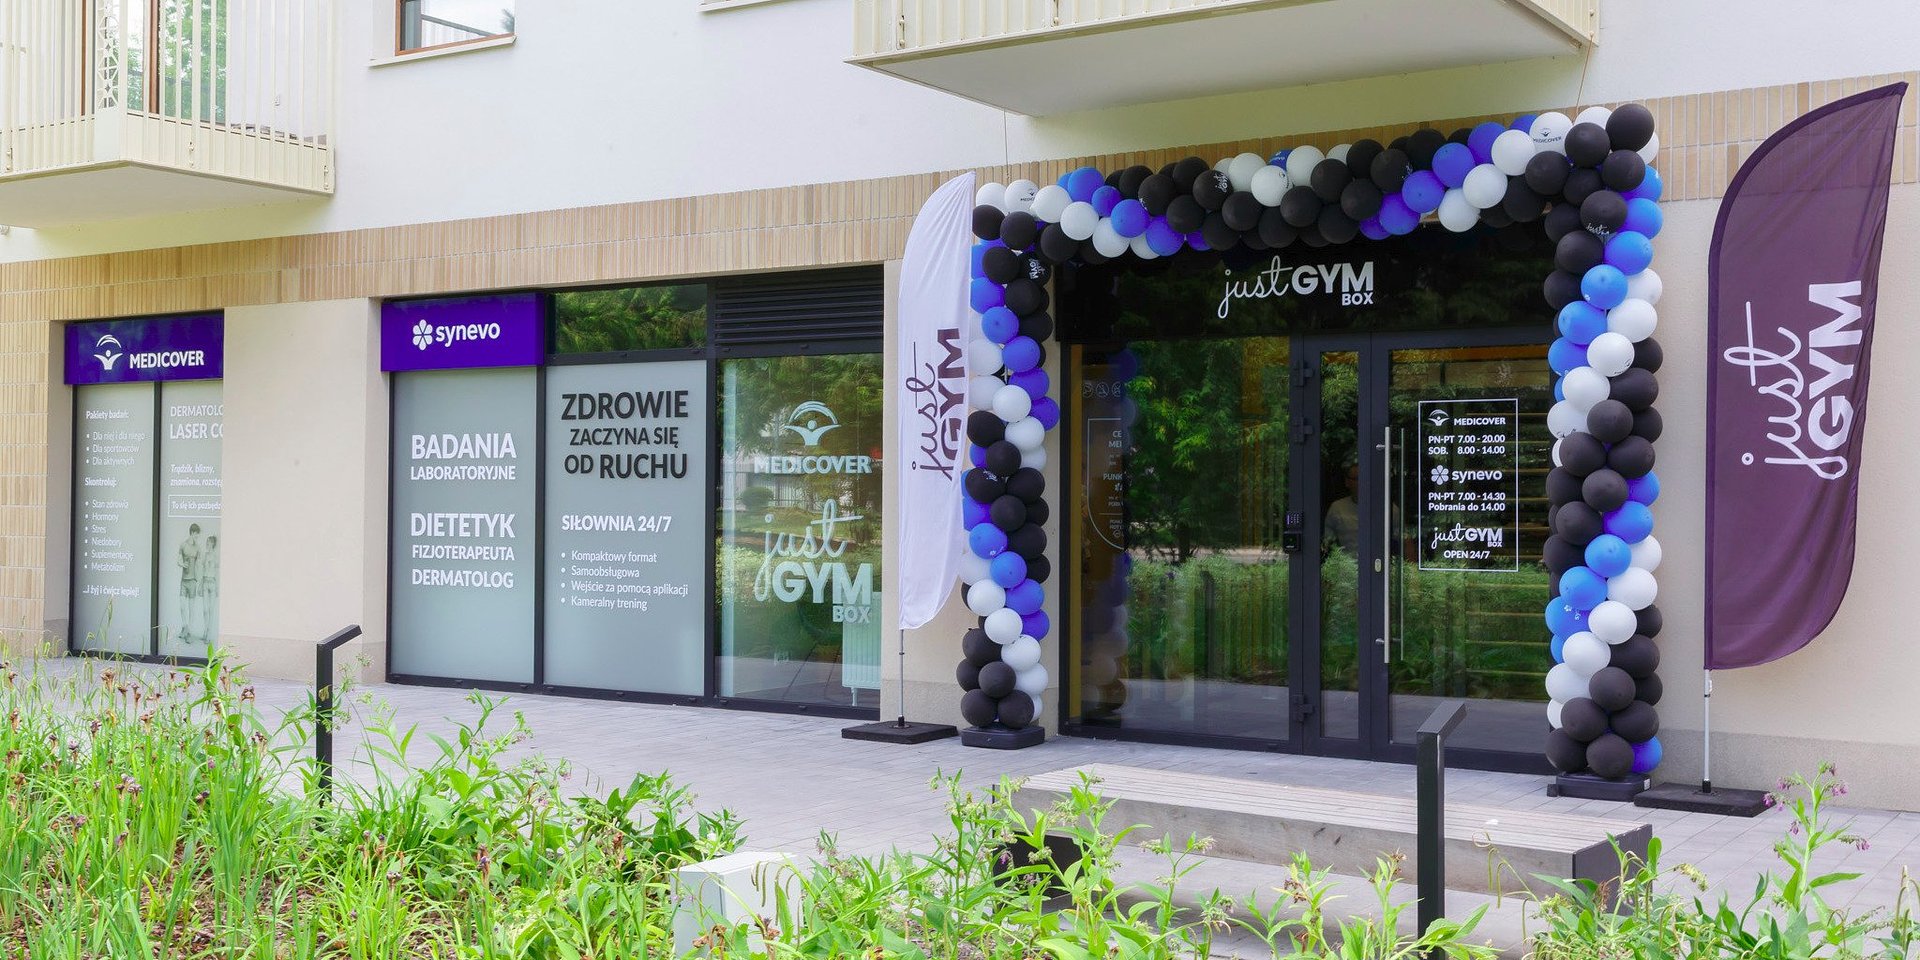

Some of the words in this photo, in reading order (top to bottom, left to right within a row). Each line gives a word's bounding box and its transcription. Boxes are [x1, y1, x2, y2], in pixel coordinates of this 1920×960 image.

[1217, 255, 1293, 319] just
[1291, 261, 1374, 295] GYM
[1341, 292, 1374, 306] BOX
[435, 322, 501, 347] synevo
[129, 350, 205, 369] MEDICOVER
[1808, 280, 1863, 451] GYM
[937, 328, 966, 461] GYM
[1723, 301, 1848, 480] just
[561, 390, 689, 420] ZDROWIE
[906, 341, 953, 482] just
[86, 410, 108, 420] Pakiety
[1453, 417, 1506, 426] MEDICOVER
[170, 423, 208, 440] LASER
[570, 428, 650, 446] ZACZYNA
[653, 427, 679, 449] SIĘ
[1428, 435, 1455, 444] PN-PT
[1457, 435, 1476, 443] 7.00
[1481, 434, 1506, 443] 20.00
[411, 433, 516, 459] BADANIA
[1428, 446, 1449, 455] SOB.
[1457, 446, 1475, 455] 8.00
[1482, 446, 1505, 455] 14.00
[411, 465, 516, 480] LABORATORYJNE
[564, 454, 594, 475] OD
[600, 453, 688, 479] RUCHU
[754, 455, 872, 475] MEDICOVER
[1451, 470, 1503, 484] synevo
[1428, 492, 1455, 501] PN-PT
[1458, 492, 1476, 501] 7.00
[1482, 492, 1506, 501] 14.30
[1428, 502, 1466, 511] Pobrania
[1467, 503, 1479, 511] do
[1480, 502, 1506, 511] 14.00
[92, 512, 119, 522] Hormony
[411, 513, 516, 538] DIETETYK
[561, 515, 635, 531] SIŁOWNIA
[638, 515, 672, 532] 24/7
[1431, 522, 1467, 549] just
[1465, 527, 1503, 542] GYM
[412, 545, 515, 561] FIZJOTERAPEUTA
[571, 550, 626, 564] Kompaktowy
[628, 551, 657, 563] format
[753, 499, 864, 602] just
[1443, 550, 1469, 559] OPEN
[1469, 550, 1490, 559] 24/7
[412, 569, 514, 589] DERMATOLOG
[571, 565, 640, 578] Samoobsługowa
[571, 581, 604, 593] Wejście
[605, 583, 615, 592] za
[617, 584, 651, 597] pomocą
[653, 583, 688, 597] aplikacji
[772, 562, 873, 604] GYM
[571, 597, 615, 609] Kameralny
[616, 598, 648, 611] trening
[832, 605, 871, 624] BOX
